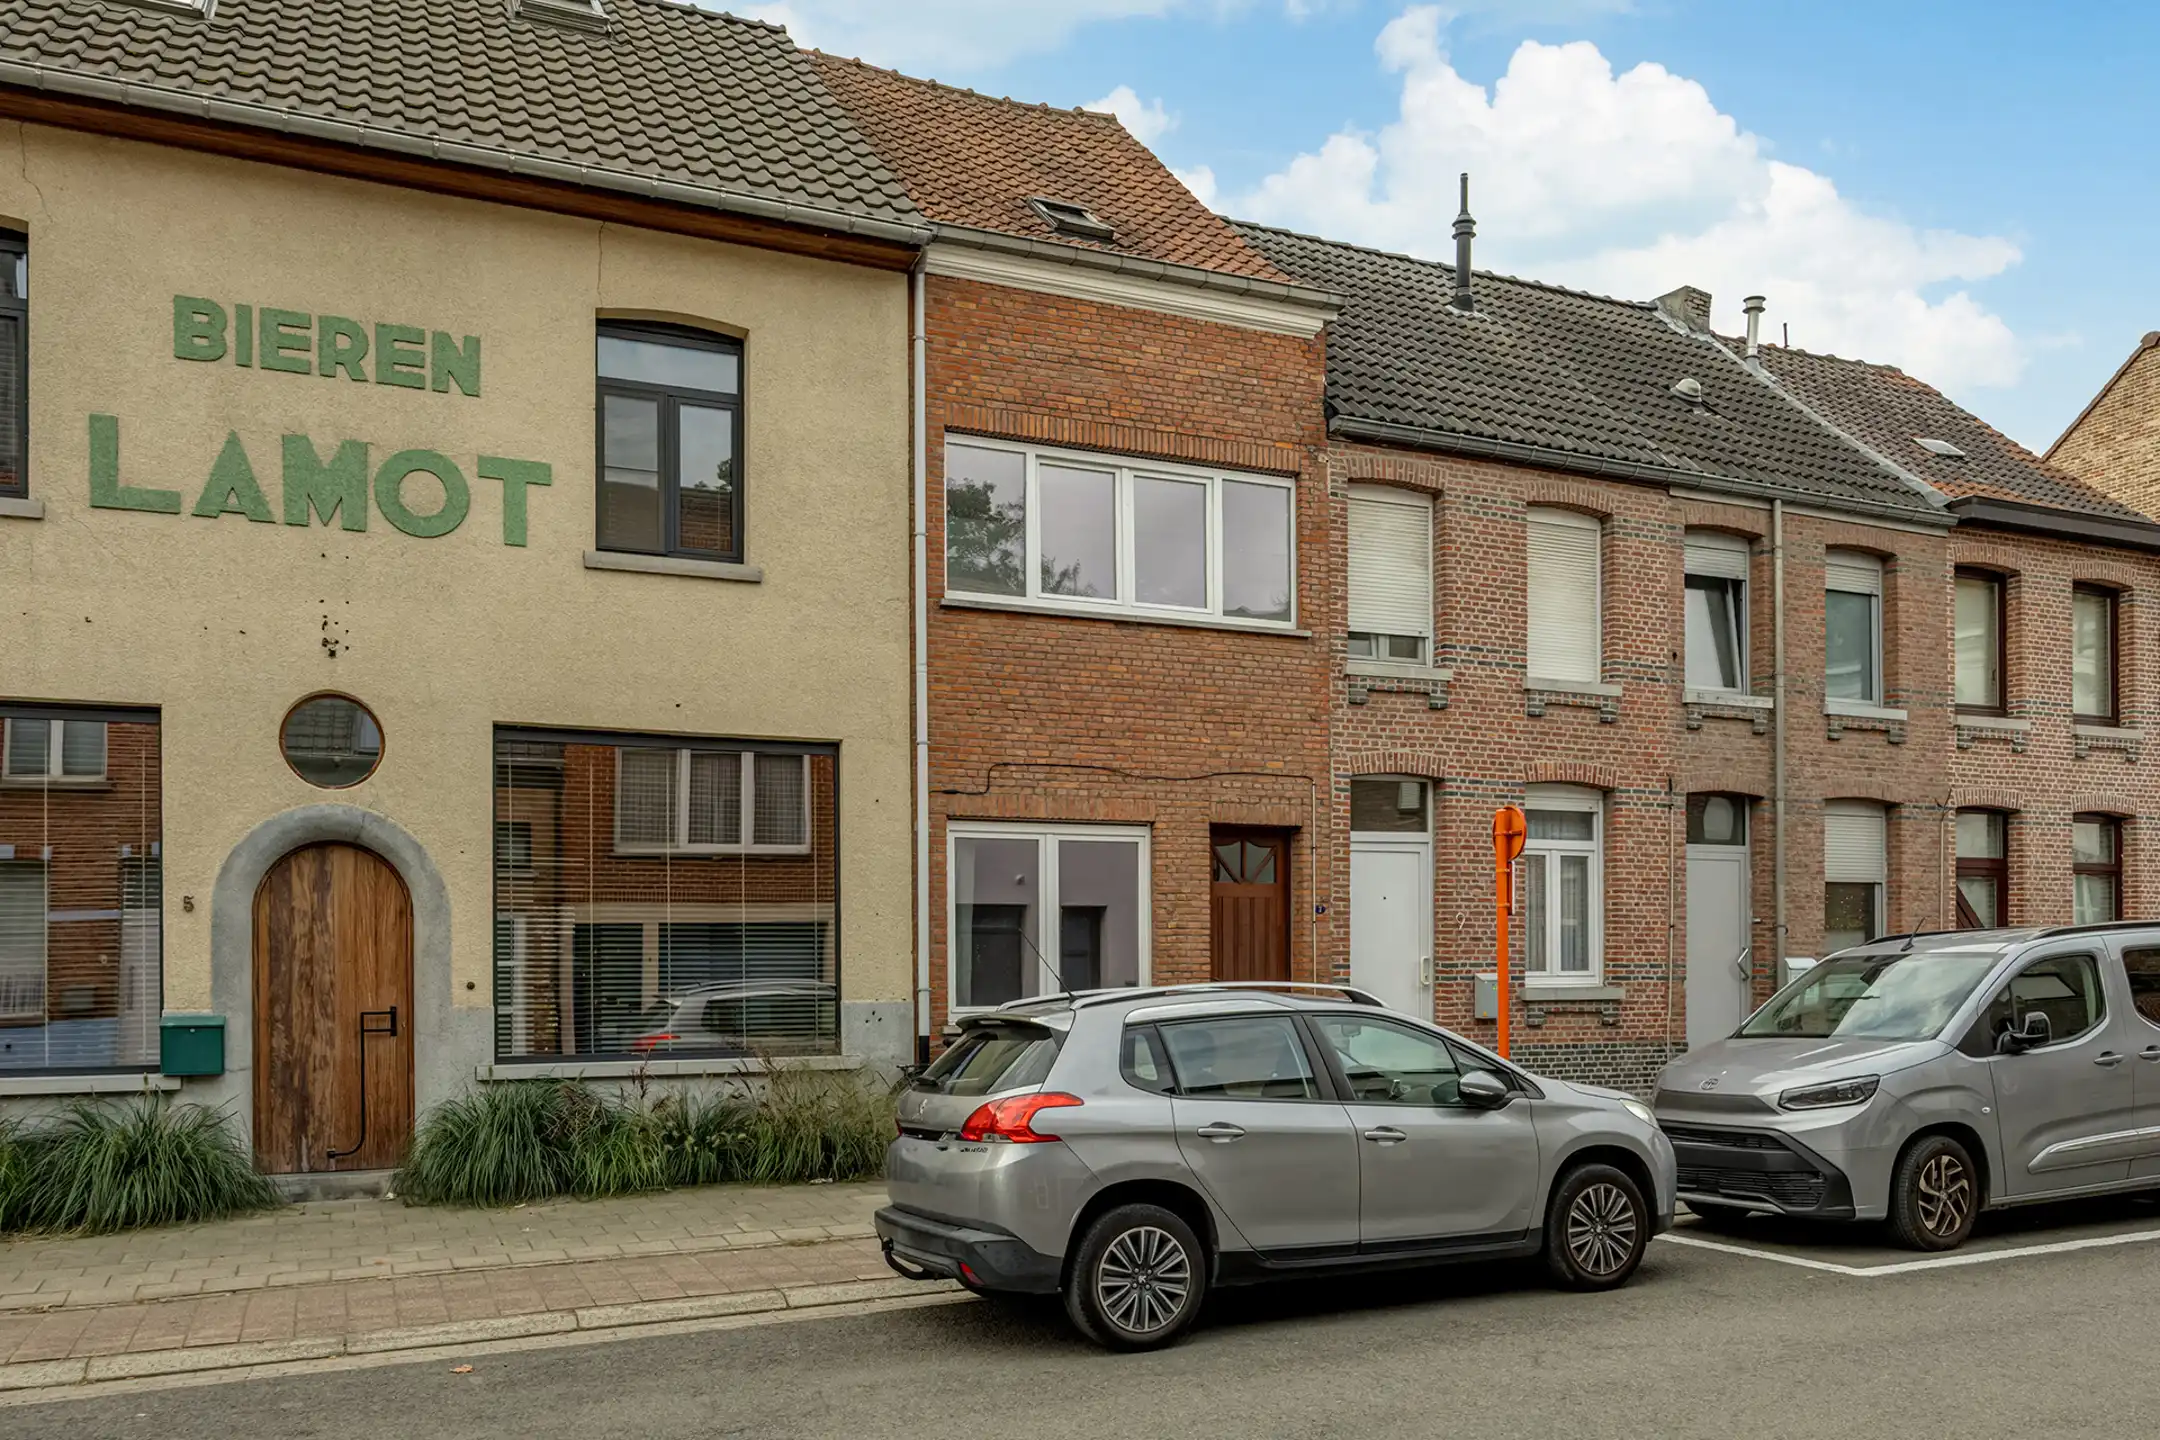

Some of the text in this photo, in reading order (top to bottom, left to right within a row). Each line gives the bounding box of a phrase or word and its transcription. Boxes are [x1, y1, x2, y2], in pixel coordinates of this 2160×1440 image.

[173, 295, 481, 397] BIEREN
[88, 413, 552, 548] LAMOT
[183, 895, 194, 913] 5
[1455, 911, 1466, 930] 9
